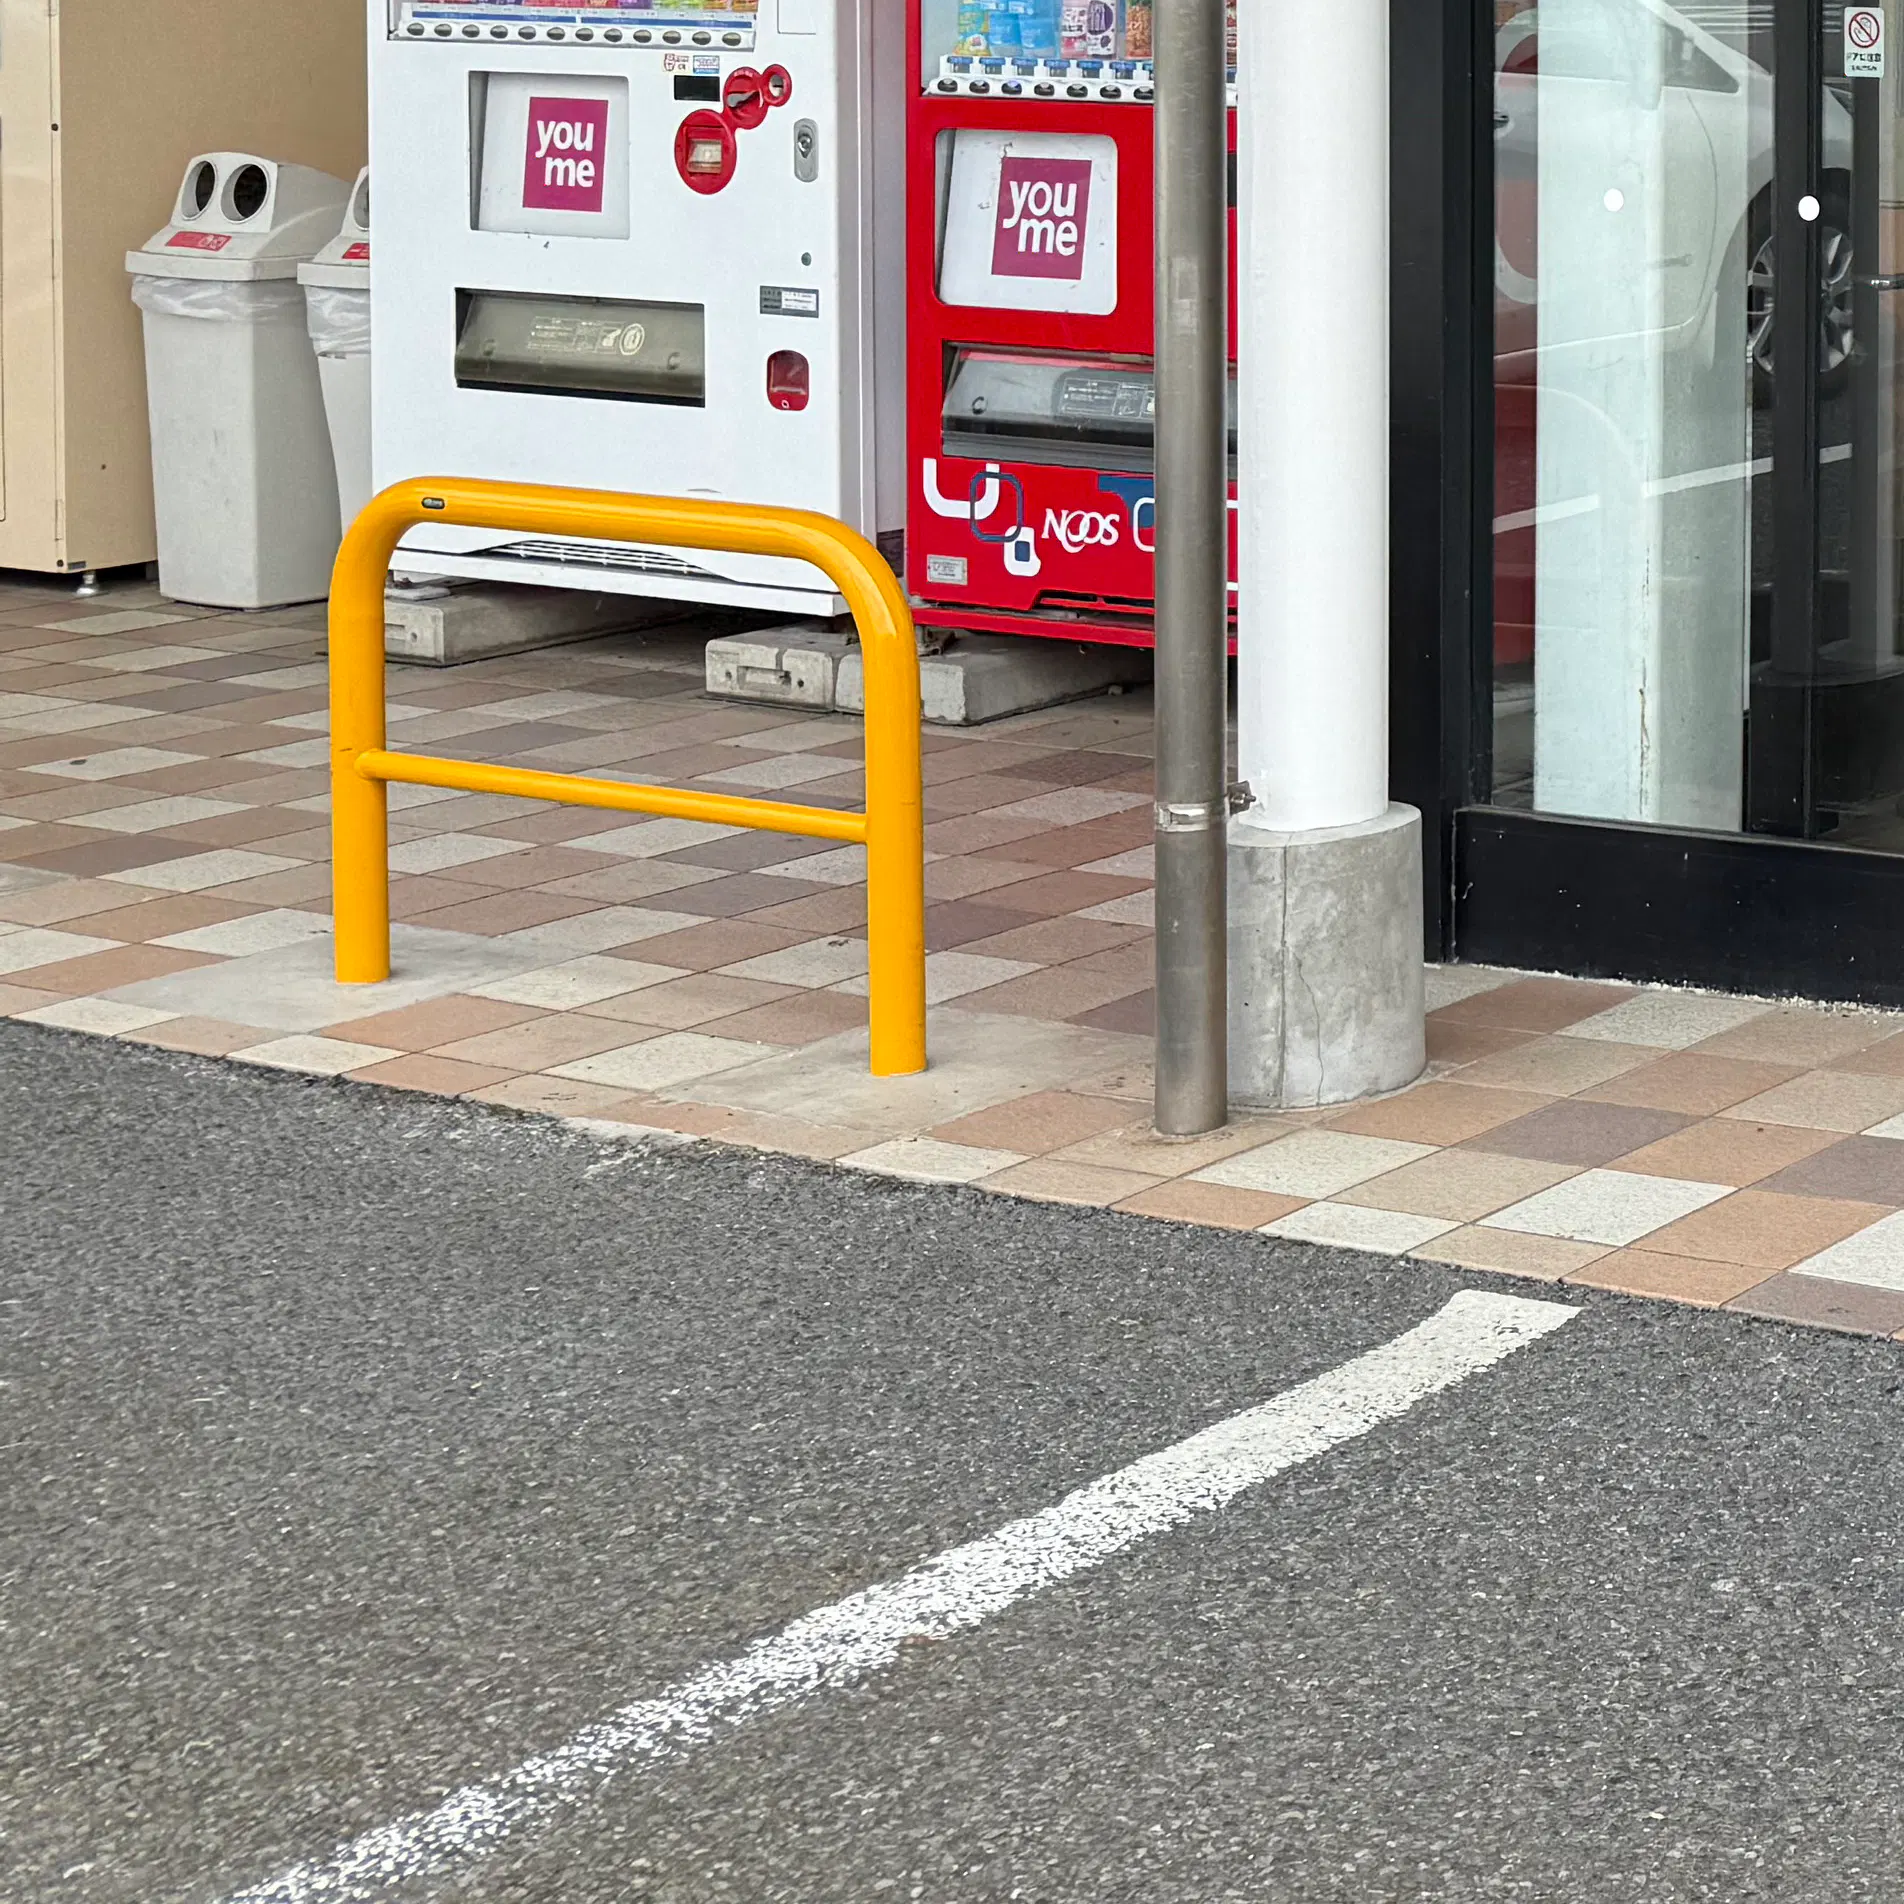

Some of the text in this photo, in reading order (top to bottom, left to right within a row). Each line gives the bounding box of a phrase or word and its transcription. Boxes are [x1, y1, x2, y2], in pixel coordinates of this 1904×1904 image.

[535, 118, 594, 159] you
[544, 156, 595, 189] me
[1002, 179, 1078, 230] you
[1018, 222, 1078, 258] me
